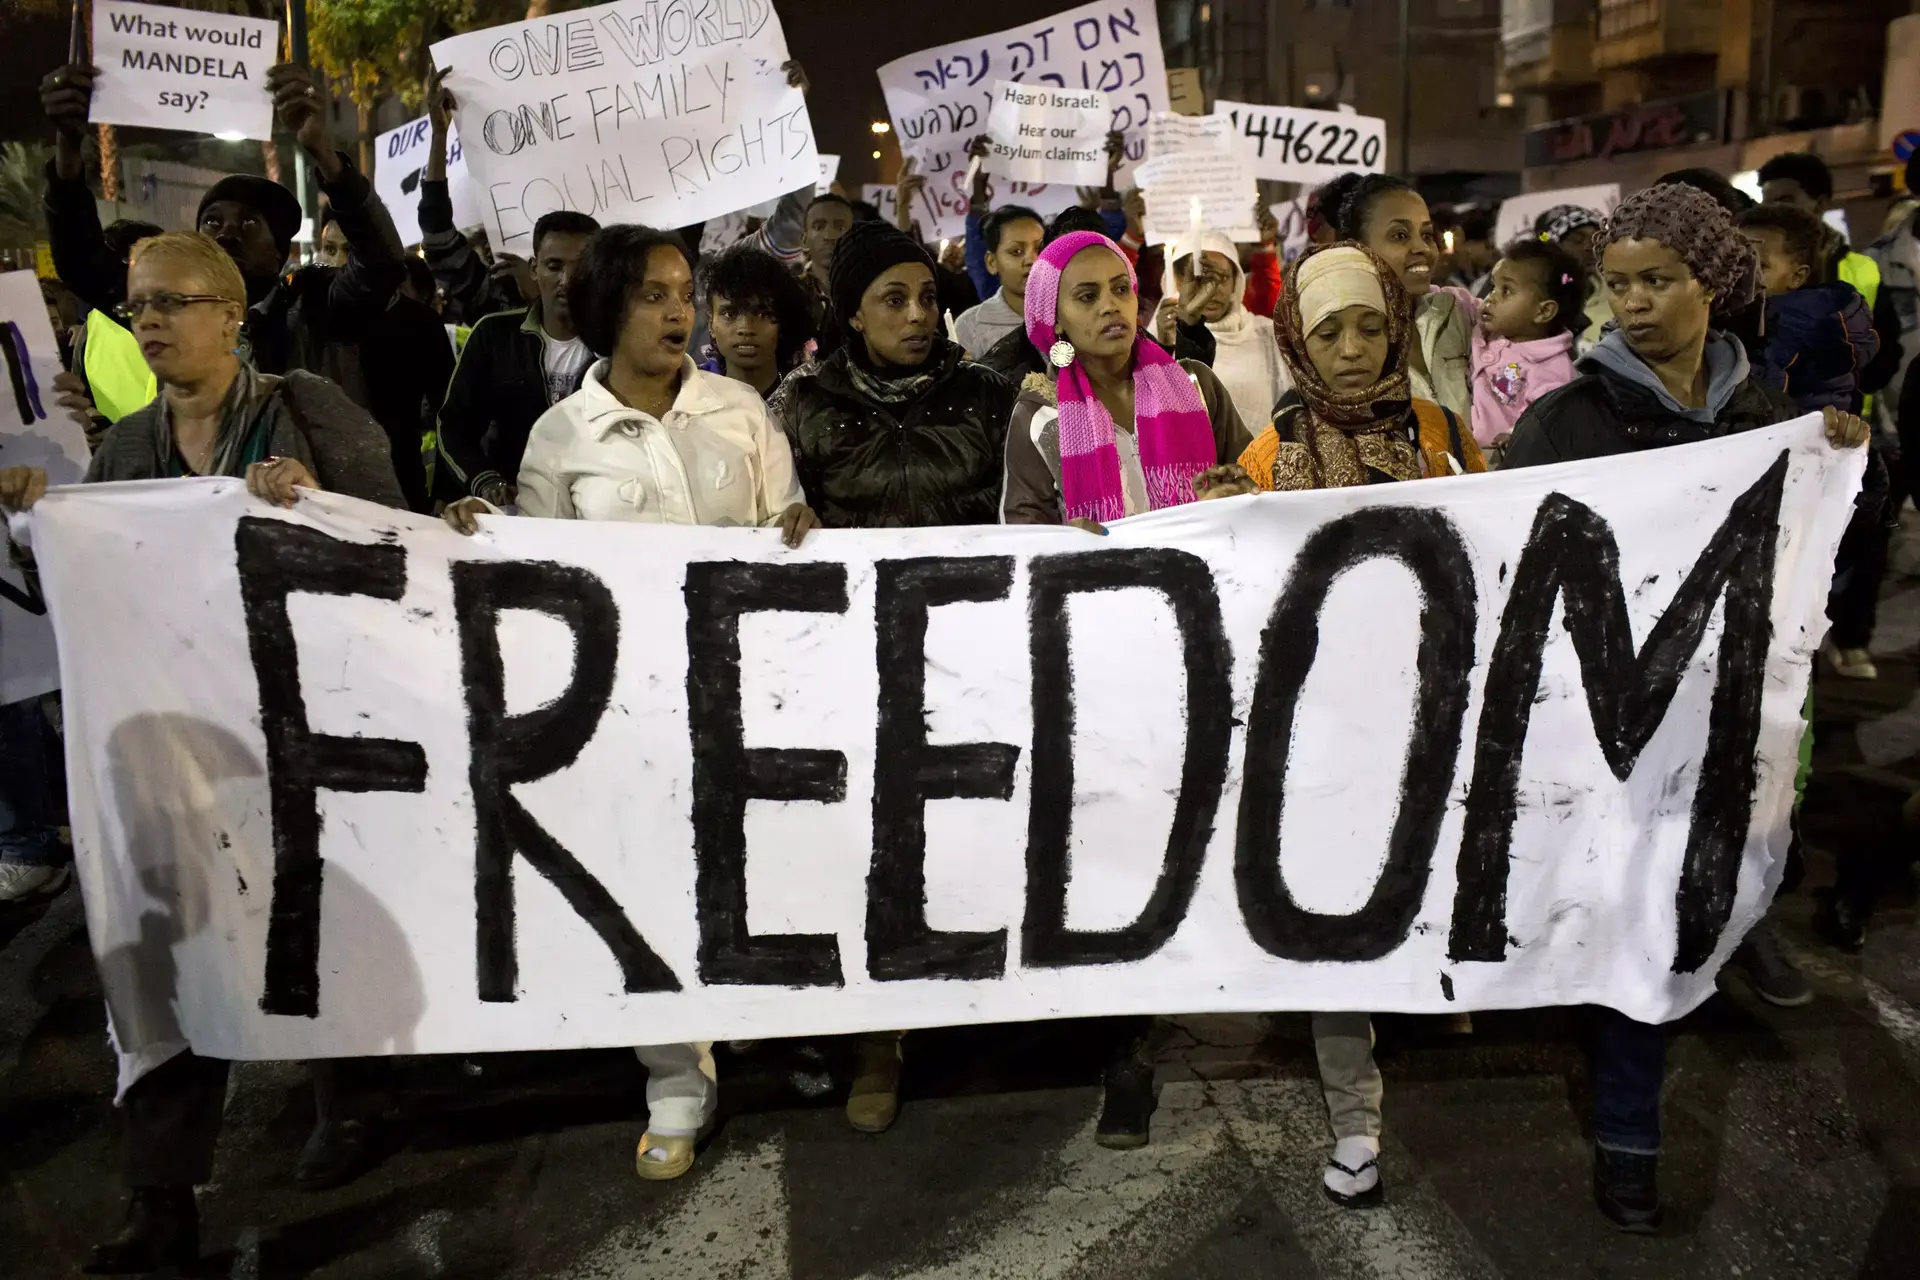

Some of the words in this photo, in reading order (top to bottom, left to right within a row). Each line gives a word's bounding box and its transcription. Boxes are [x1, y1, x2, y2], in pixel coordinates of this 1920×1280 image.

[110, 12, 177, 39] What
[186, 26, 262, 50] would
[489, 18, 605, 81] ONE
[599, 0, 770, 68] WORLD
[1074, 7, 1141, 51] אם
[122, 49, 249, 80] MANDELA
[914, 49, 989, 91] נראה
[1006, 27, 1055, 73] זה
[157, 91, 209, 112] say?
[483, 94, 575, 156] ONE
[586, 61, 729, 144] FAMILY
[1004, 87, 1036, 106] Hear
[1050, 93, 1100, 109] Israel:
[388, 120, 429, 159] OUR
[1019, 123, 1047, 138] Hear
[1050, 127, 1077, 139] our
[993, 143, 1041, 161] asylum
[1044, 146, 1098, 162] claims!
[489, 154, 655, 246] EQUAL
[660, 105, 809, 195] RIGHTS
[235, 447, 1790, 1018] FREEDOM
